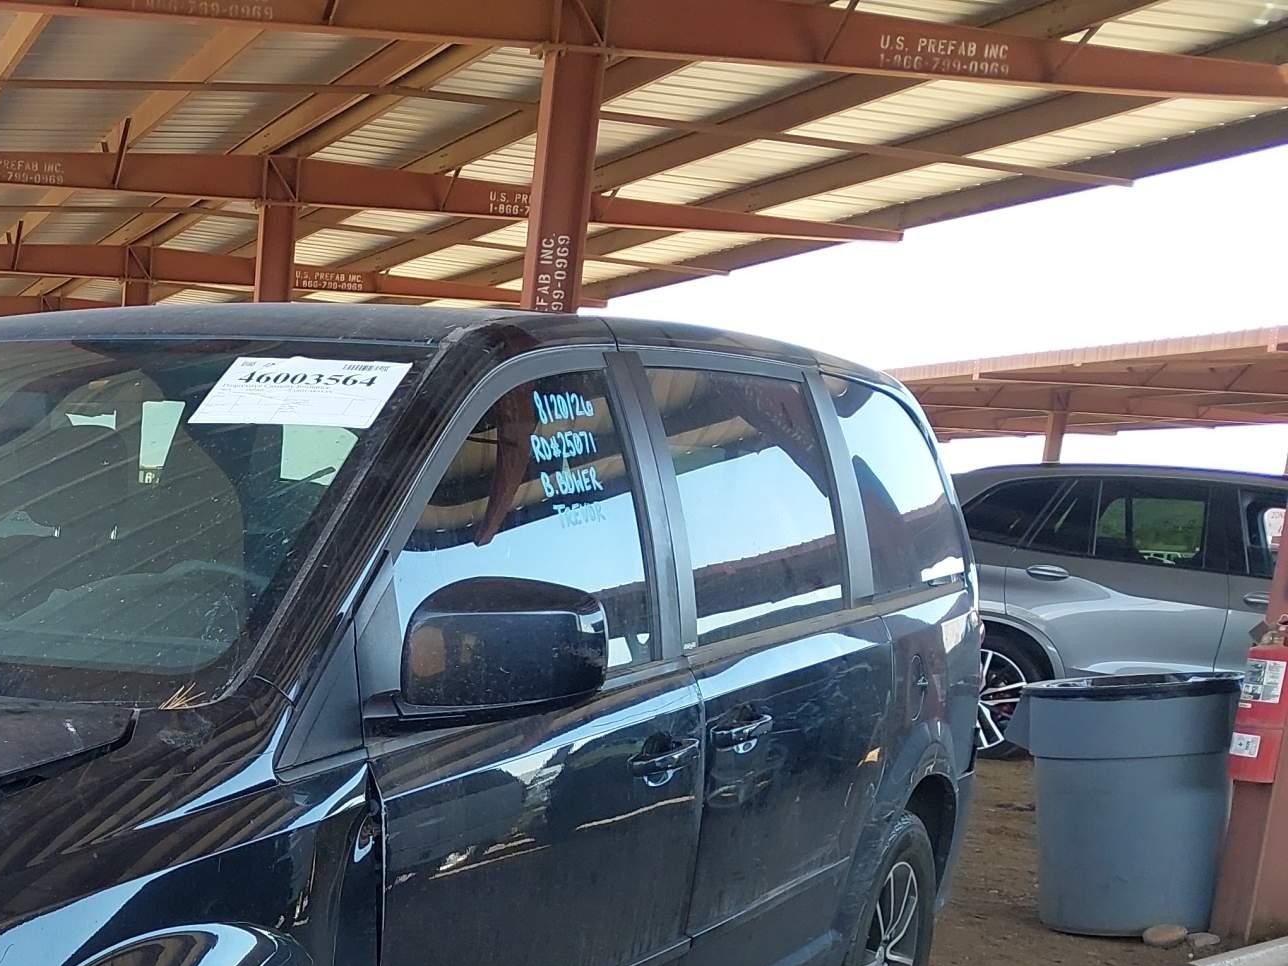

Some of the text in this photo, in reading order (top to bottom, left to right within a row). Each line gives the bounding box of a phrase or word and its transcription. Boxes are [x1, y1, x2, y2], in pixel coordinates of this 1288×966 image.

[880, 34, 909, 51] U.S.
[917, 37, 977, 56] PREFAB
[489, 191, 532, 204] U.S. PR
[314, 271, 345, 282] PREFAB
[534, 232, 556, 312] FAB INC.
[295, 278, 363, 291] 1866-799-0969
[237, 370, 378, 387] 46003564
